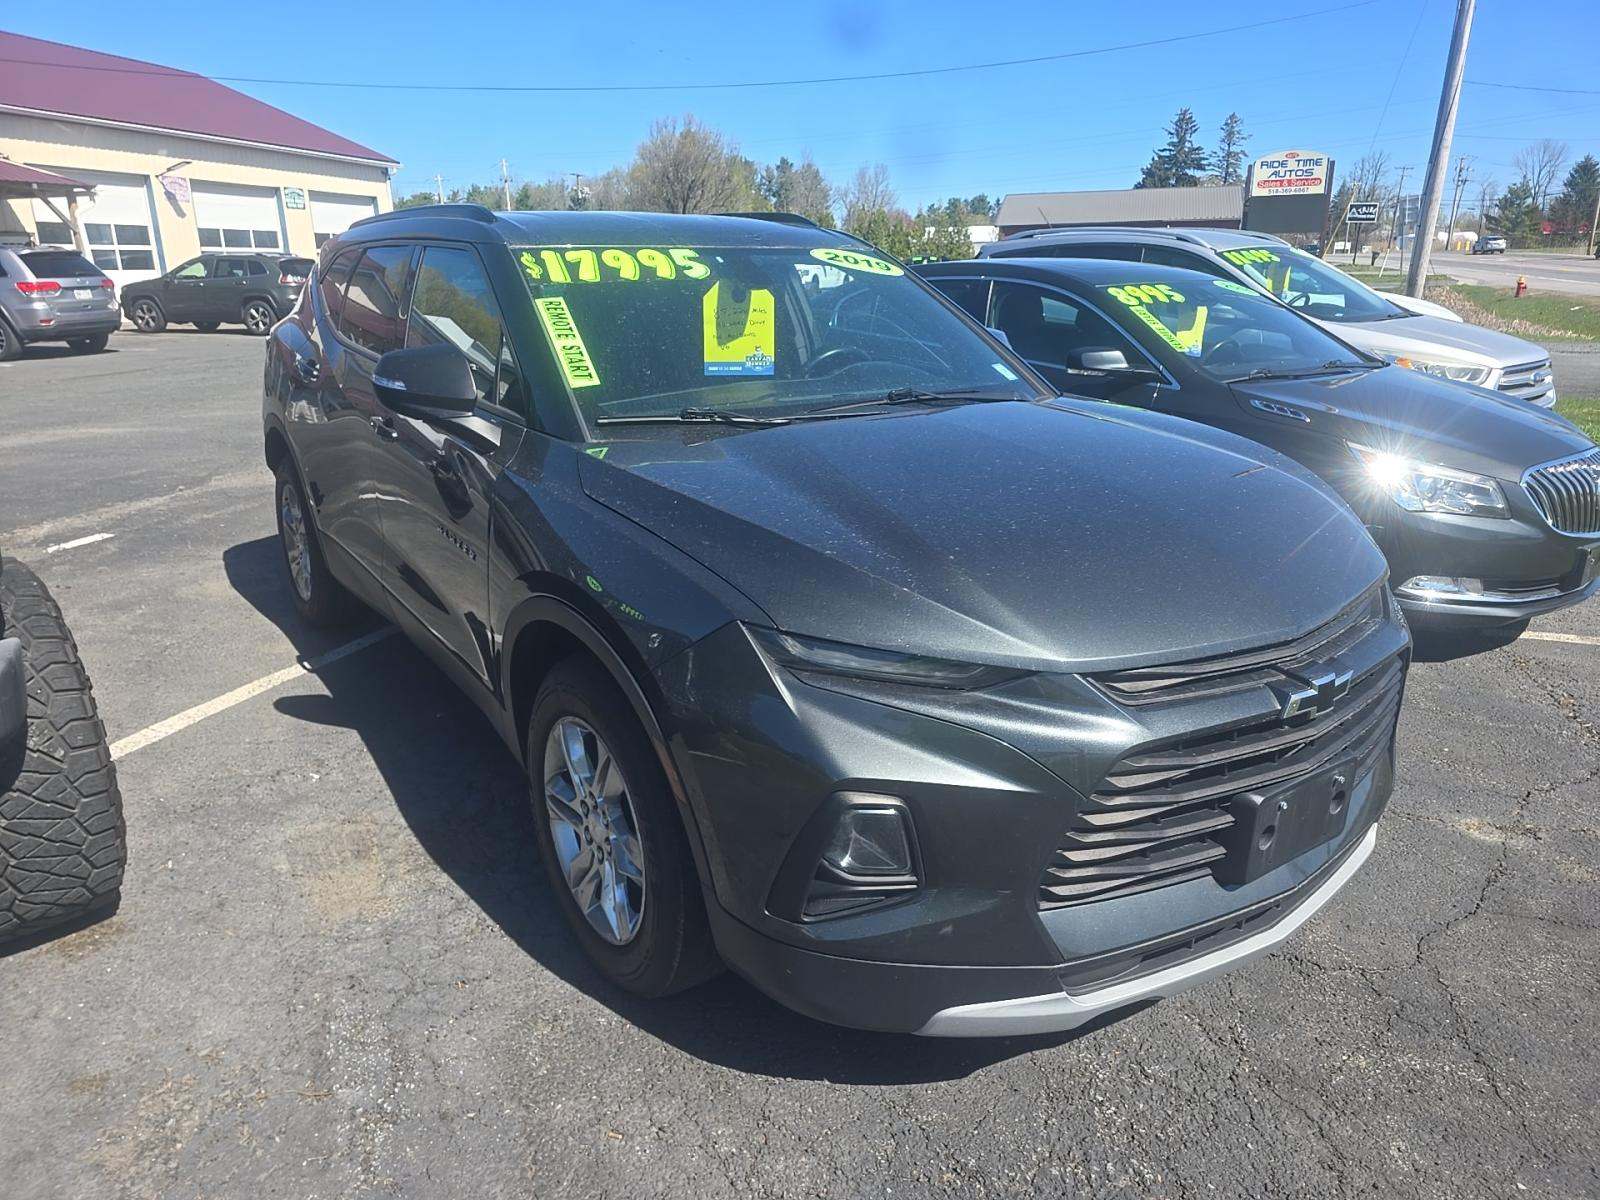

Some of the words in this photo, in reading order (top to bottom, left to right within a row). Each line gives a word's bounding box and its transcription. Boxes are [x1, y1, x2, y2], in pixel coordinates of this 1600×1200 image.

[1260, 160, 1289, 169] RIDE
[1294, 158, 1323, 167] TIME
[1267, 168, 1315, 179] AUTOS
[1258, 180, 1281, 188] Sales
[1290, 178, 1320, 187] Service
[520, 248, 711, 283] $17995
[823, 250, 893, 272] 2019
[1107, 284, 1186, 306] 8995
[544, 300, 576, 340] REMOTE
[562, 344, 594, 381] START
